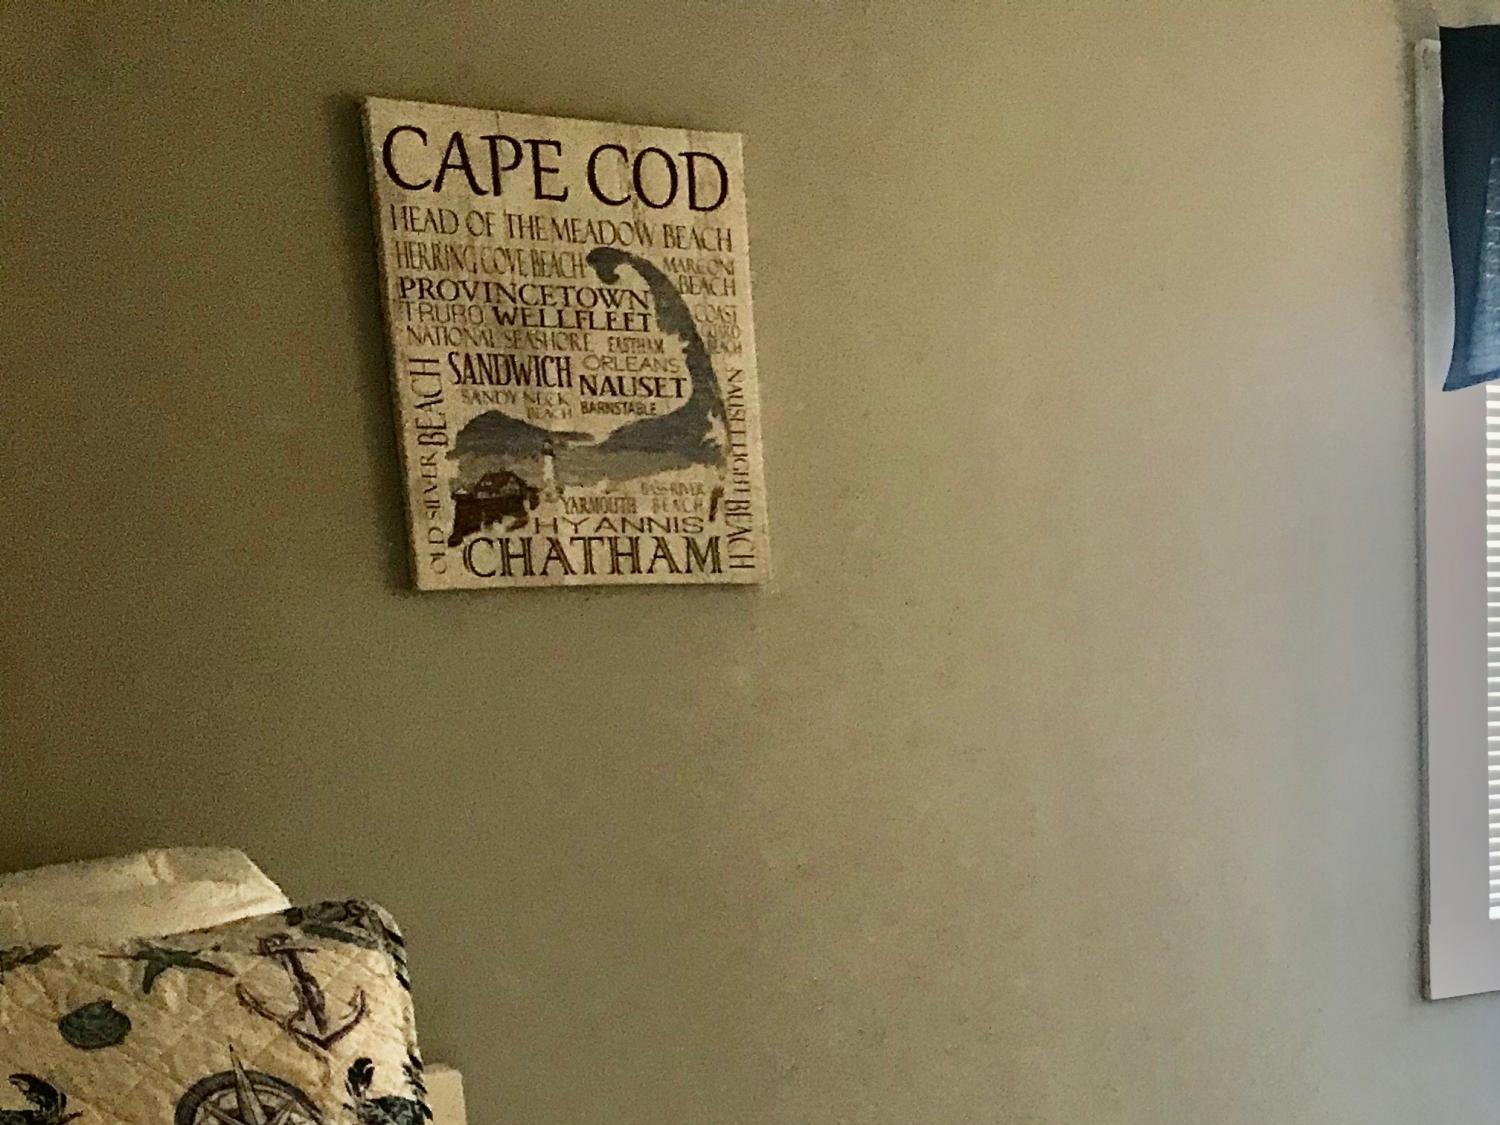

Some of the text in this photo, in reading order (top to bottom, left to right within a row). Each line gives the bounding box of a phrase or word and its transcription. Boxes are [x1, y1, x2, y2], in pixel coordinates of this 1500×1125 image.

[382, 125, 729, 212] CAPE COD
[390, 203, 732, 252] HEAD OF THE MEADOW BEACH
[395, 241, 586, 279] HERRING COVE BEACH
[399, 276, 650, 310] PROVINCETOWN
[678, 275, 736, 296] BEACH
[400, 301, 653, 333] TRURO WELLFLEET
[405, 325, 590, 352] NATIONAL SEASHORE
[607, 336, 665, 353] EASTHAM
[448, 351, 573, 388] SANDWICH
[582, 355, 681, 374] ORLEANS
[579, 375, 687, 399] NAUSET
[727, 369, 746, 437] NAUSET
[580, 402, 657, 416] BARNSTABLE
[408, 357, 450, 574] OLD SILVER BEACH
[559, 496, 639, 515] YARMOUTH
[535, 516, 705, 535] HYANNIS
[725, 499, 756, 569] BEACH
[462, 536, 723, 578] CHATHAM
